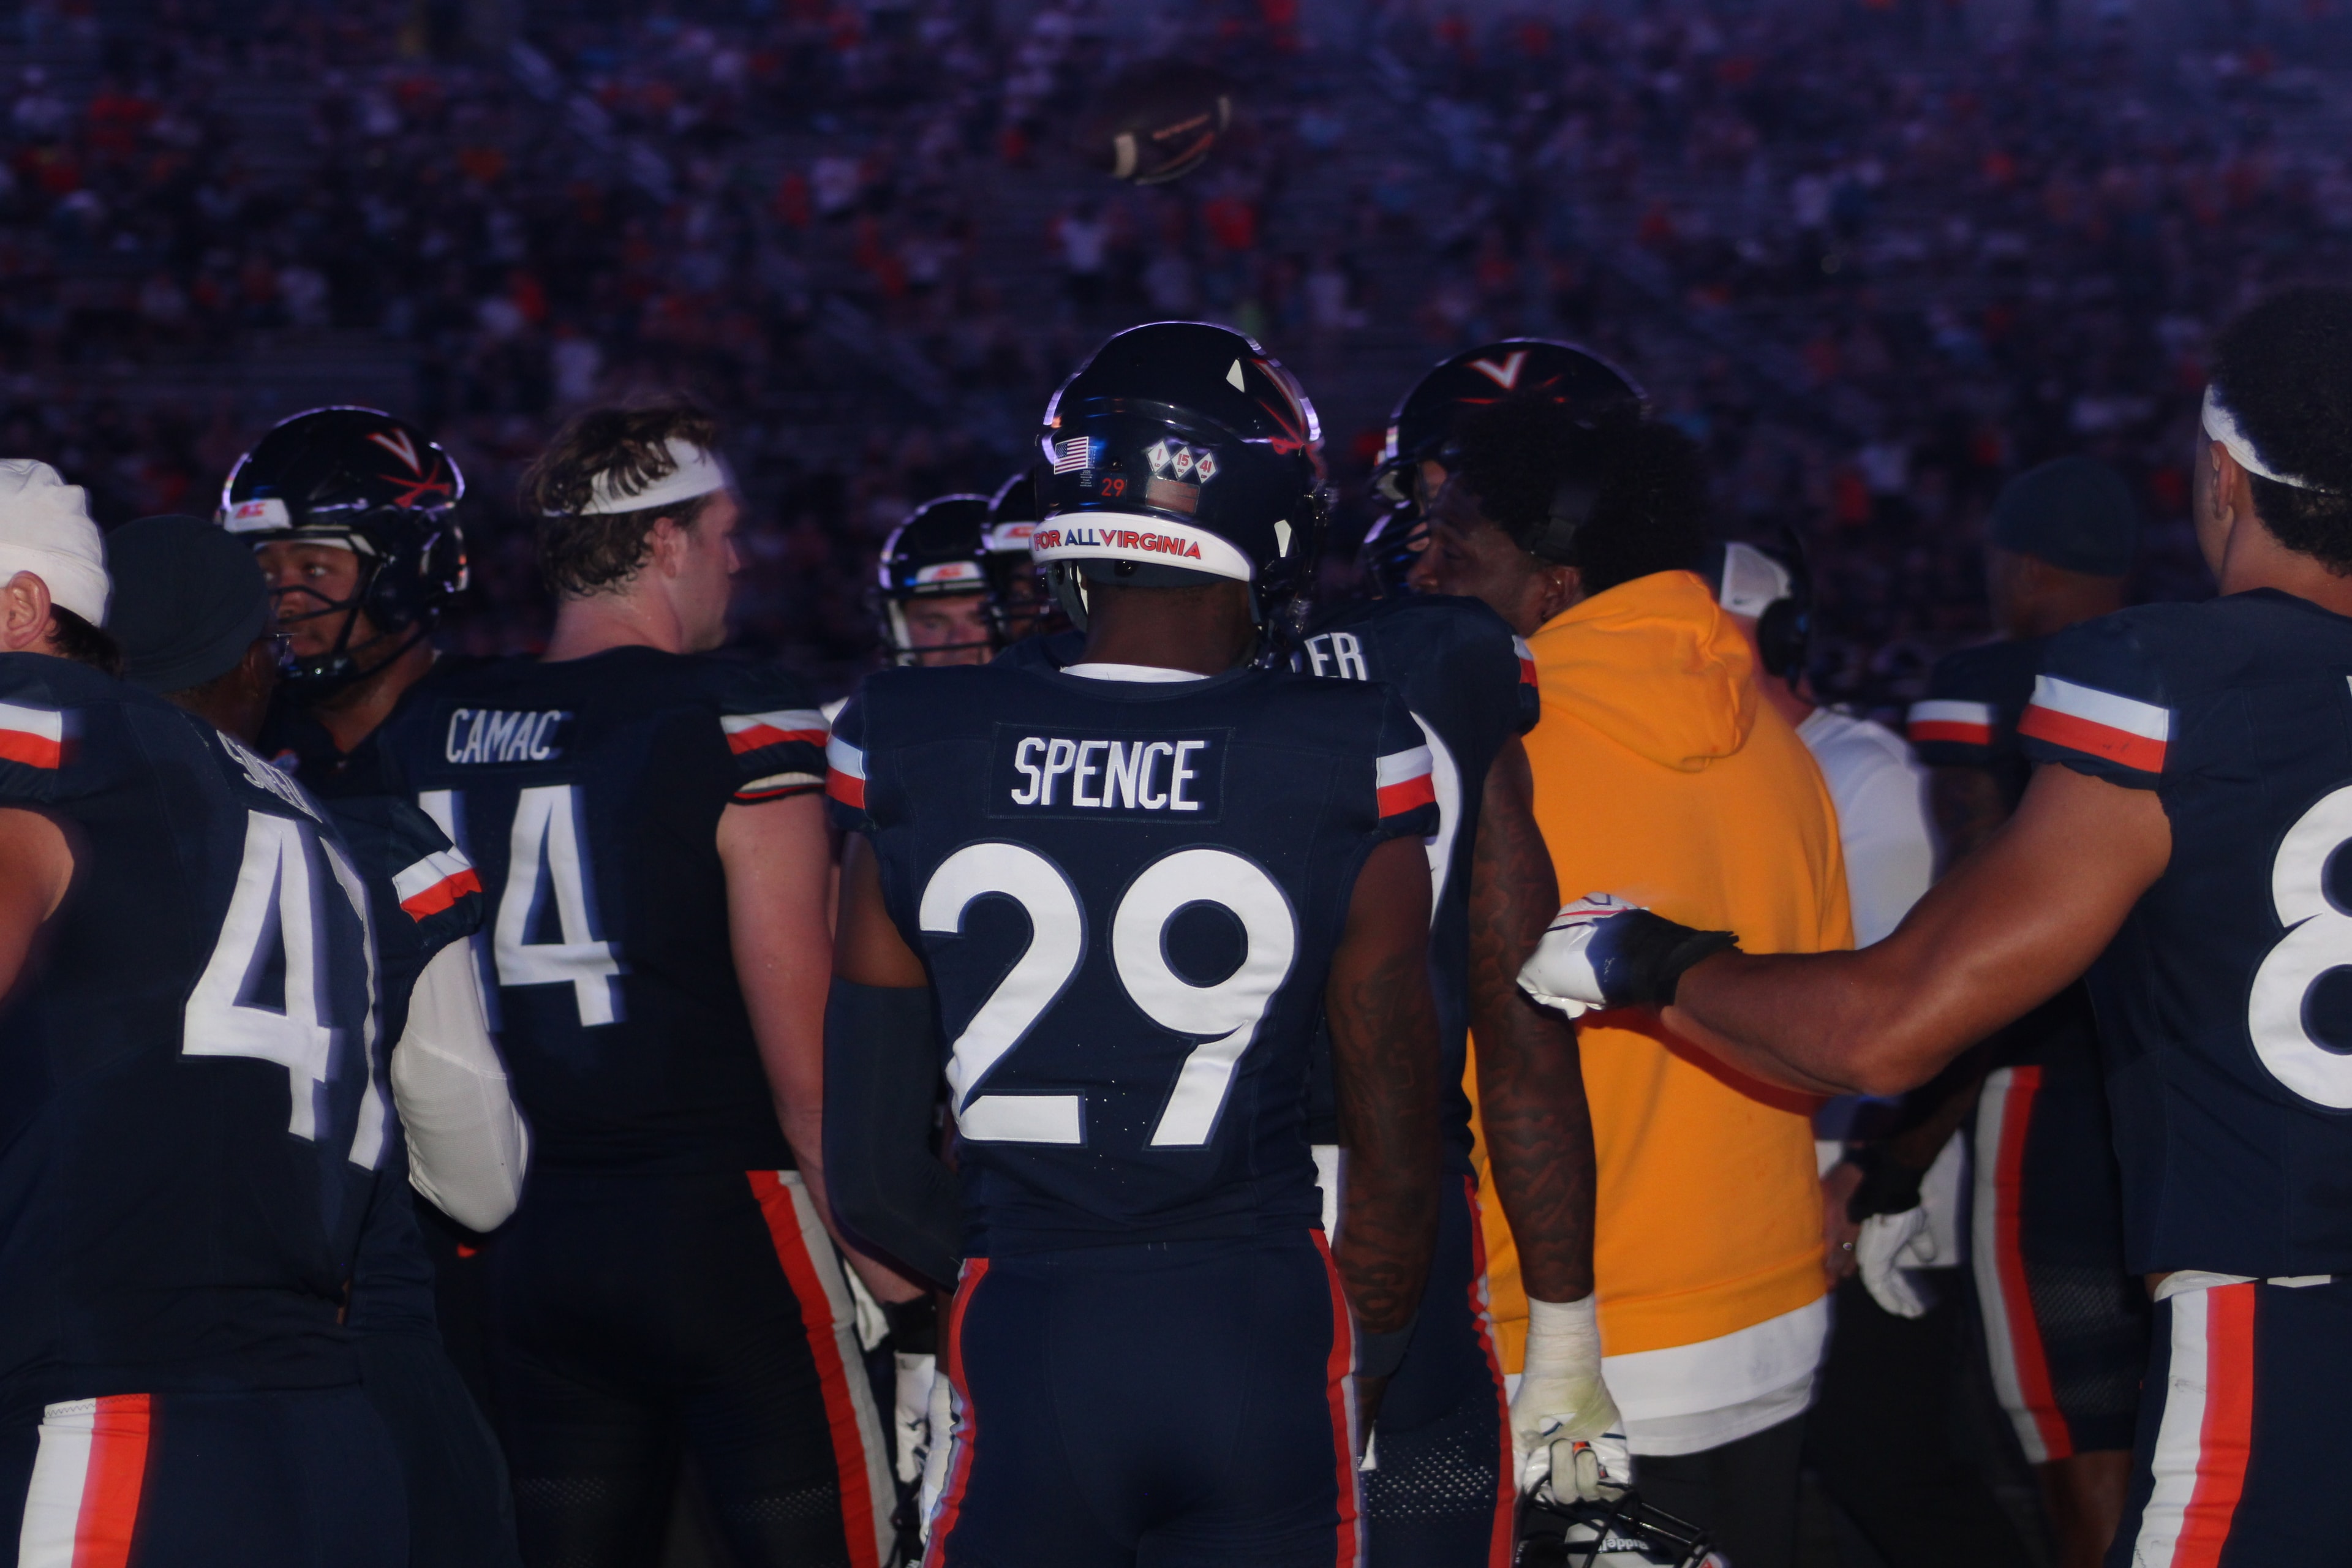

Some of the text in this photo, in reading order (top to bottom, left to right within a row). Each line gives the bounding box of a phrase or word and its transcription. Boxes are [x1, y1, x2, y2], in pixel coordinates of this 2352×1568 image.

[1177, 453, 1189, 466] 15
[1199, 460, 1212, 473] 41
[1101, 477, 1125, 497] 29
[1033, 530, 1061, 551] FOR
[1290, 632, 1368, 681] ER
[445, 708, 562, 764] CAMAC
[1011, 737, 1206, 810] SPENCE
[919, 842, 1295, 1146] 29
